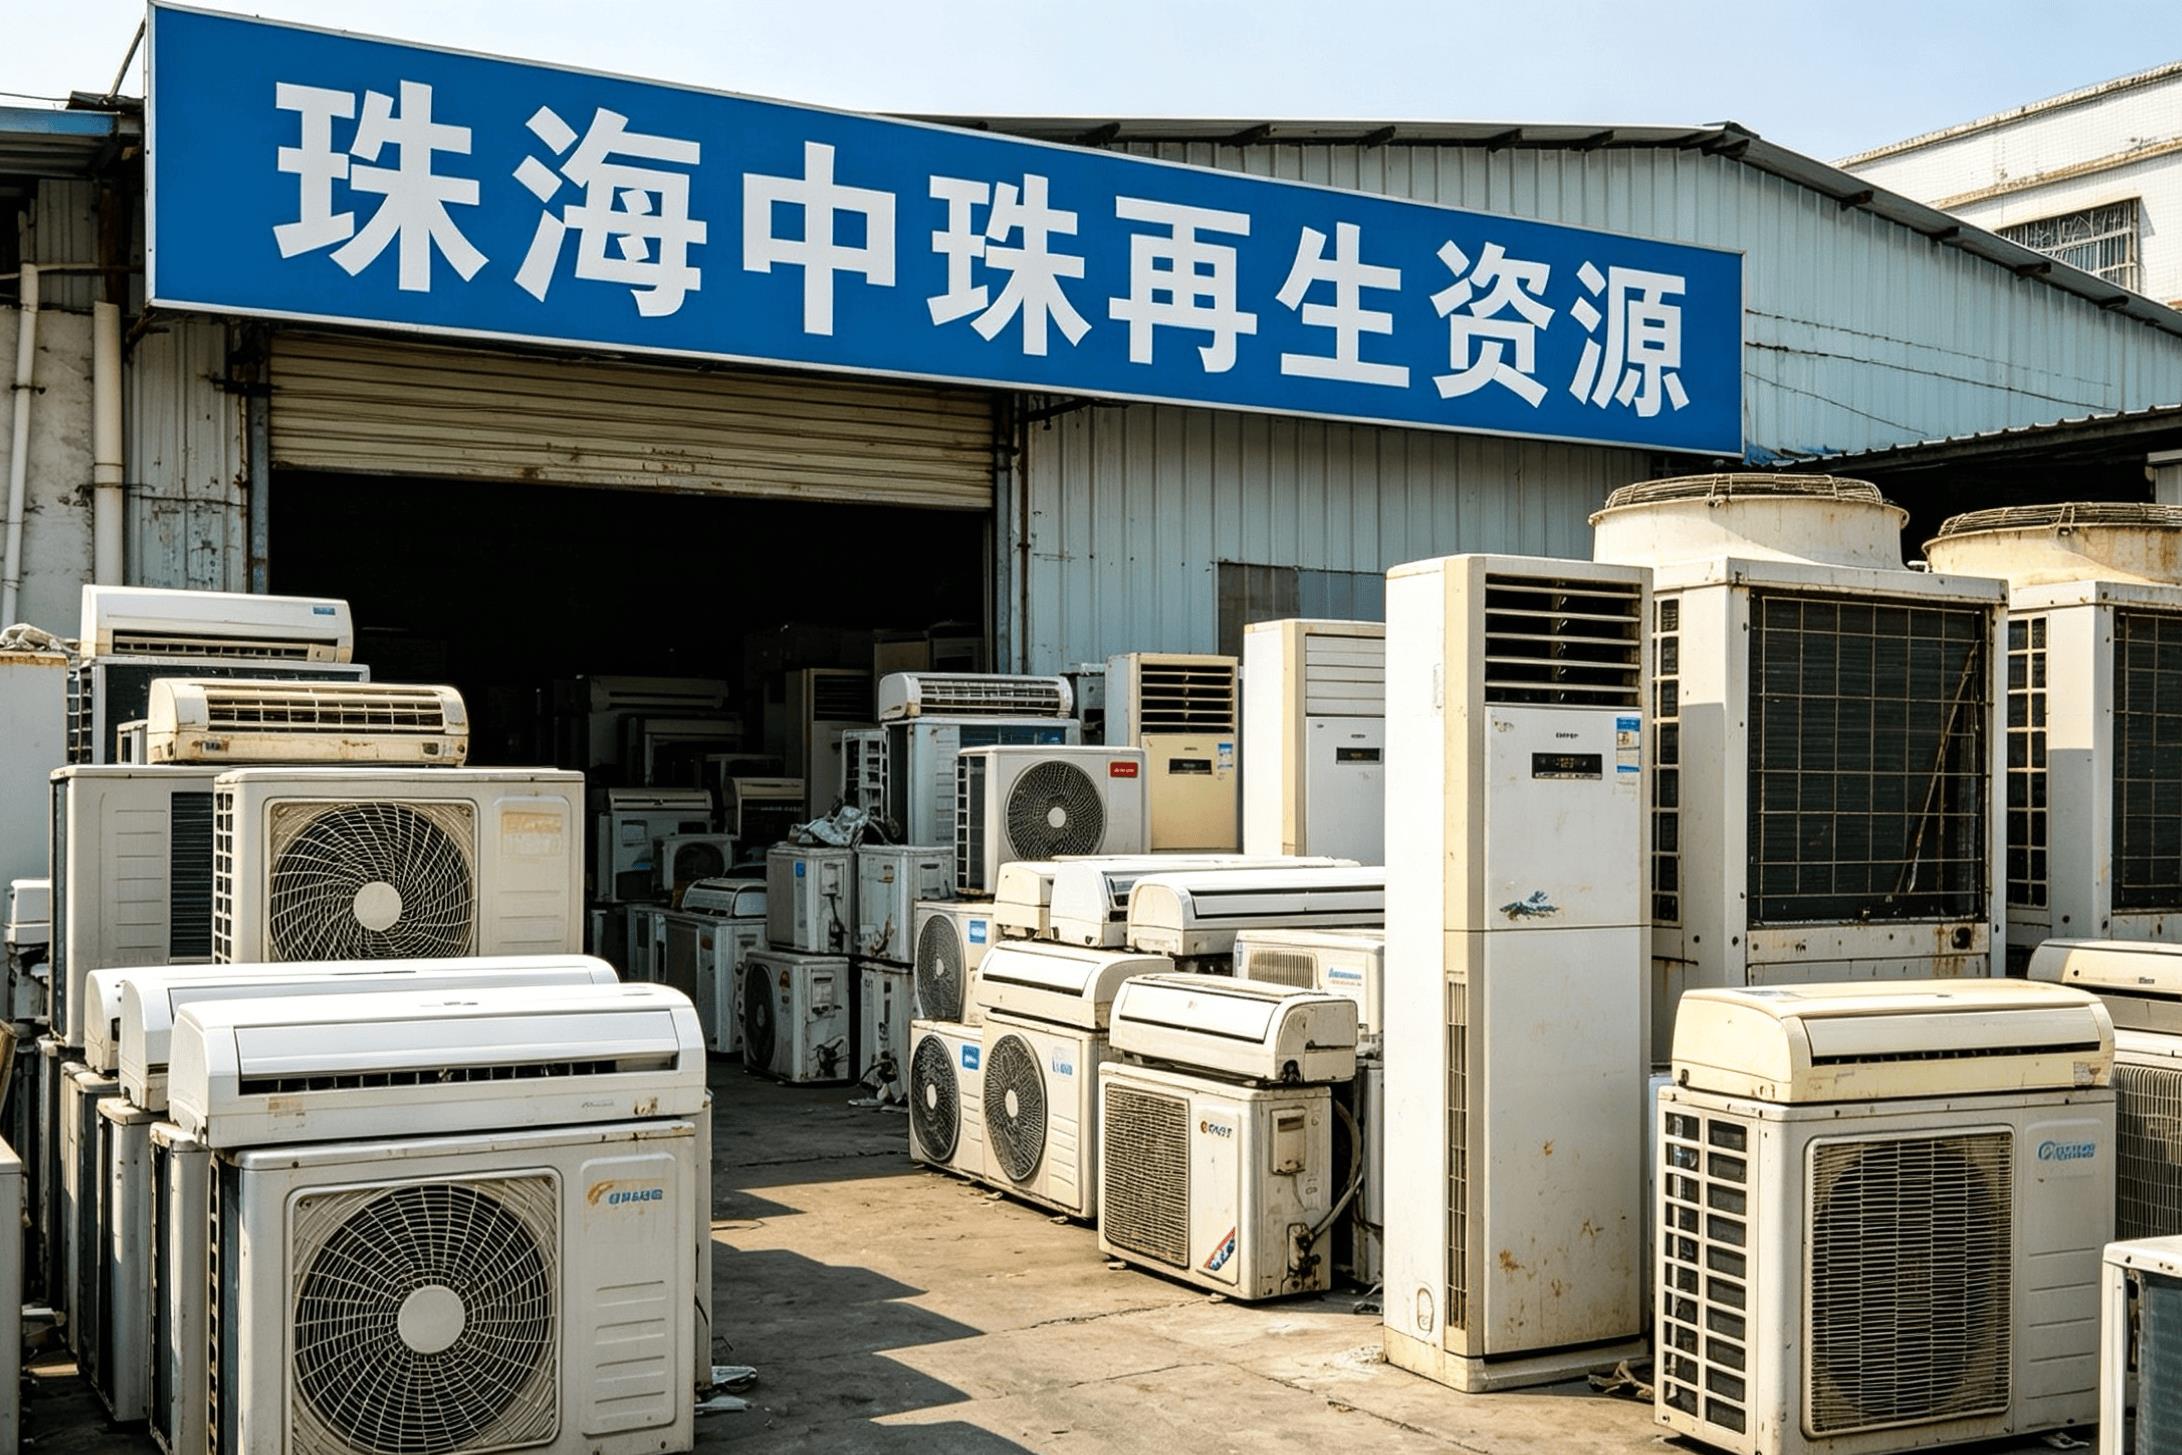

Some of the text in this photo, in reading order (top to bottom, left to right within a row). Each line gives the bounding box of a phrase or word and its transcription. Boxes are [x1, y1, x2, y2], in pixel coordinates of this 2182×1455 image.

[273, 80, 1689, 417] 珠海中珠再生资源
